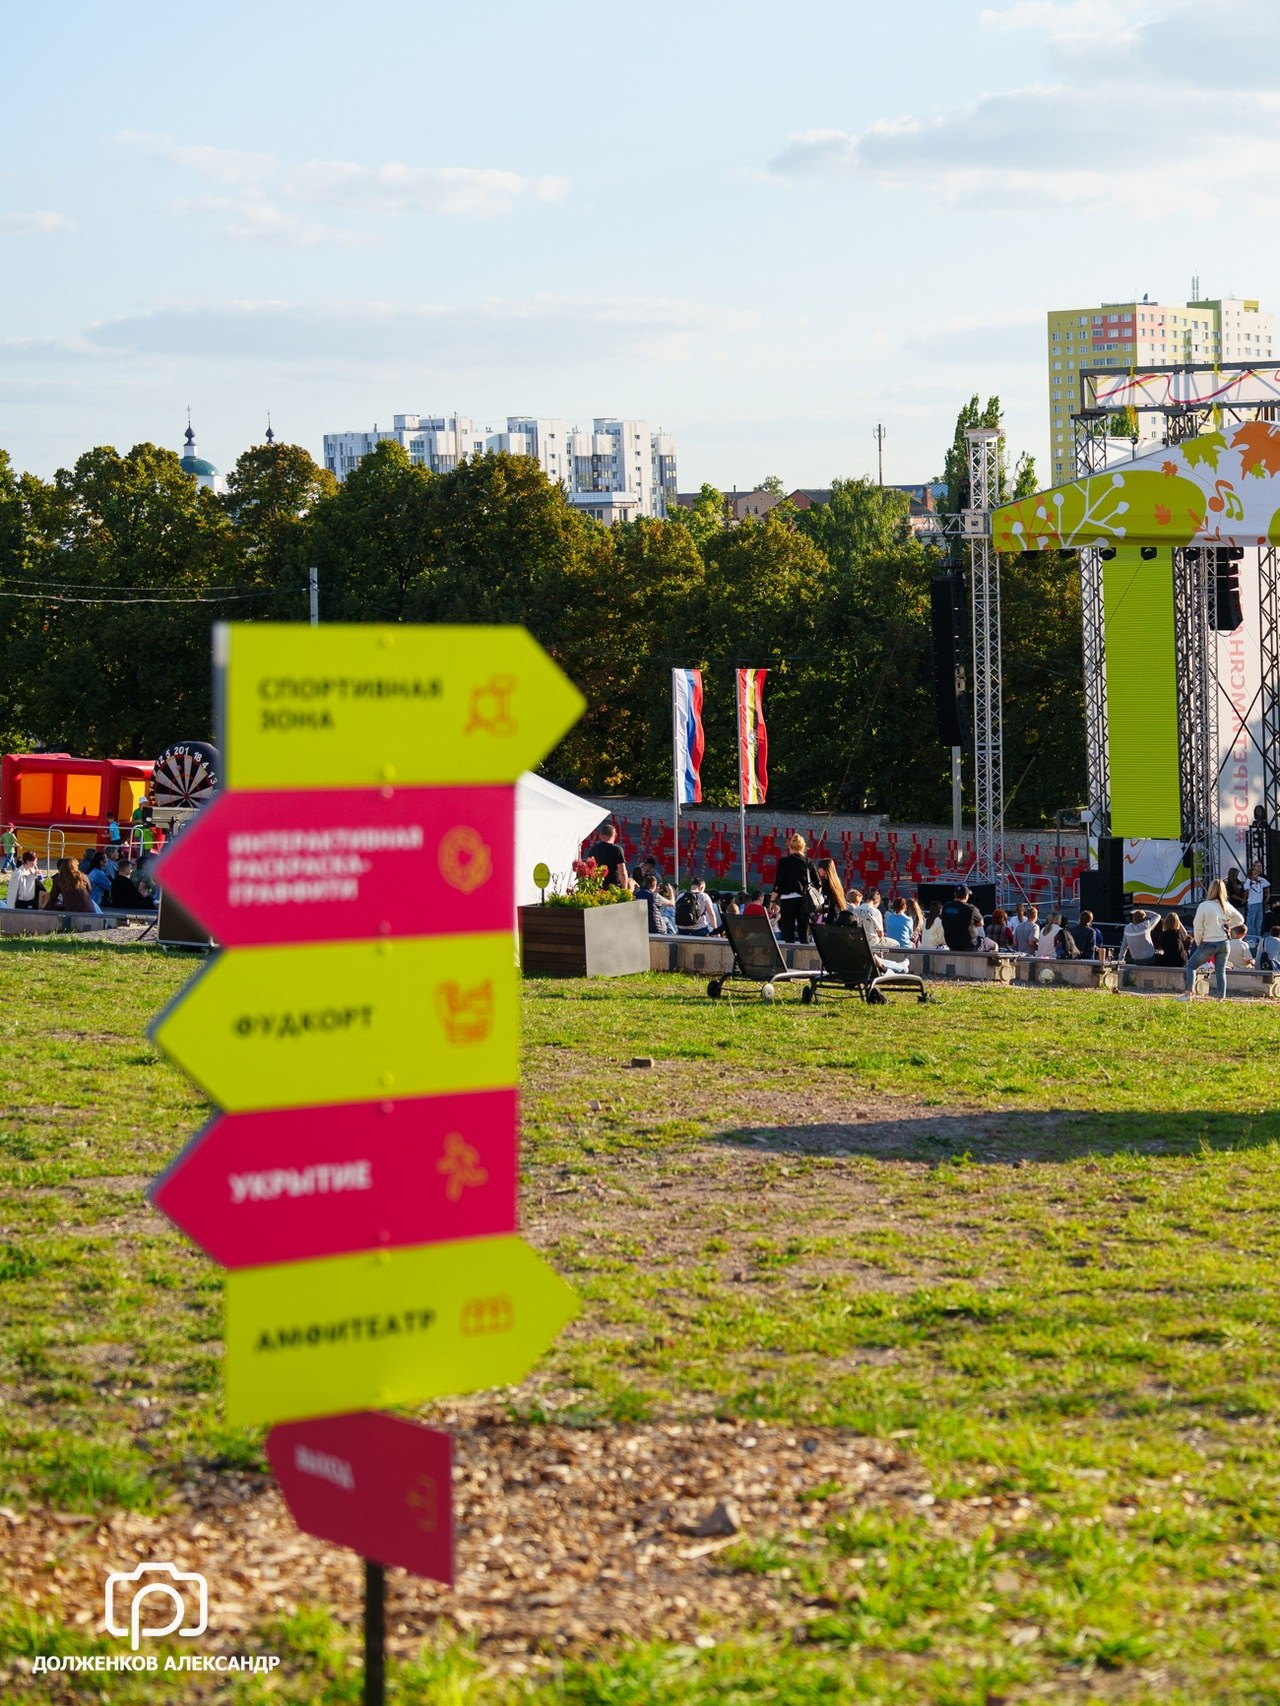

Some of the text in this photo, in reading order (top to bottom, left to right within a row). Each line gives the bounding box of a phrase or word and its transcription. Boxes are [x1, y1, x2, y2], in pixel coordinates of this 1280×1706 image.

[257, 677, 443, 702] СПОРТИВНАЯ
[257, 709, 334, 730] ЗОНА
[228, 827, 424, 855] ИНТЕРАКТИВНАЯ
[228, 855, 371, 880] РАСКРАСКА-
[228, 879, 359, 907] ГРАФФИТИ
[232, 1005, 375, 1040] ФУДКОРТ
[228, 1160, 373, 1204] УКРЫТИЕ
[255, 1310, 437, 1355] АМФИТЕАТР
